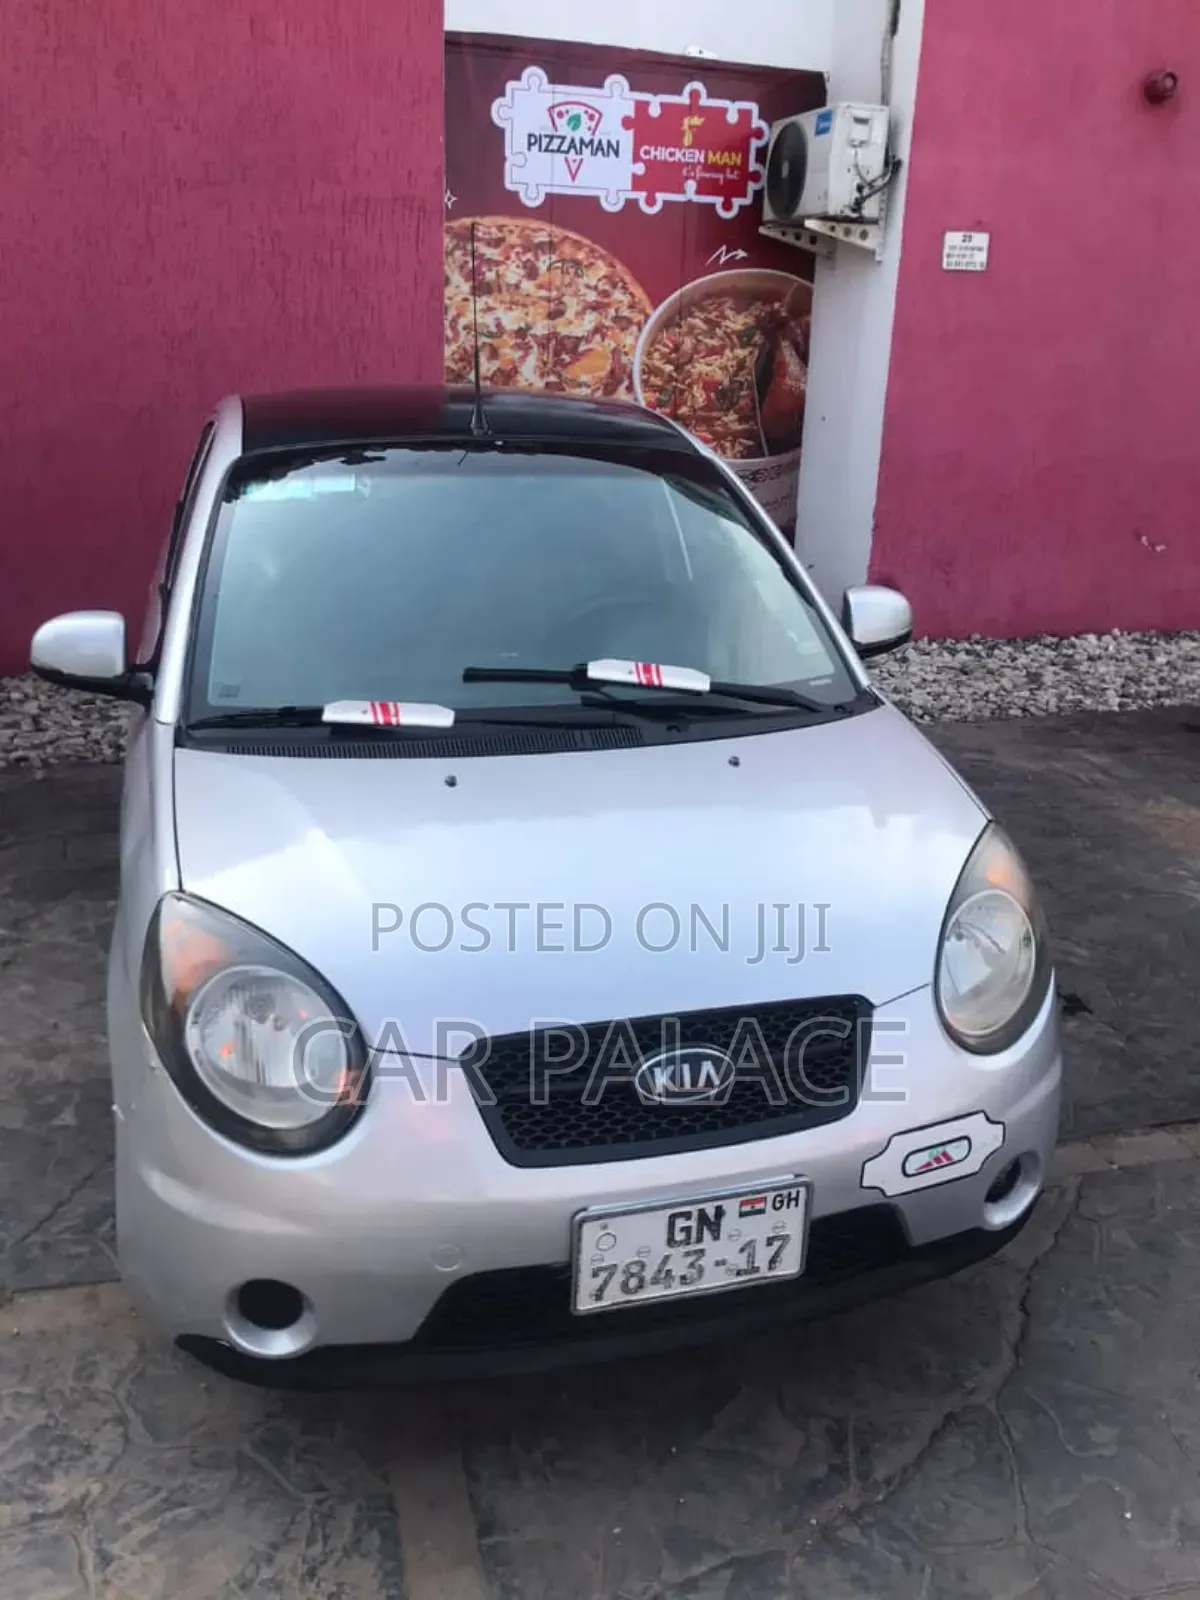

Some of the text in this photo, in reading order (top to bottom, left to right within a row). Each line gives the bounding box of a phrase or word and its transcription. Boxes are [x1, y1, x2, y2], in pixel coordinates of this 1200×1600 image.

[527, 133, 620, 158] PIZZAMAN
[639, 145, 742, 166] CHICKEN MAN
[653, 1060, 721, 1092] KIA
[771, 1190, 801, 1212] GH
[666, 1204, 726, 1249] GN
